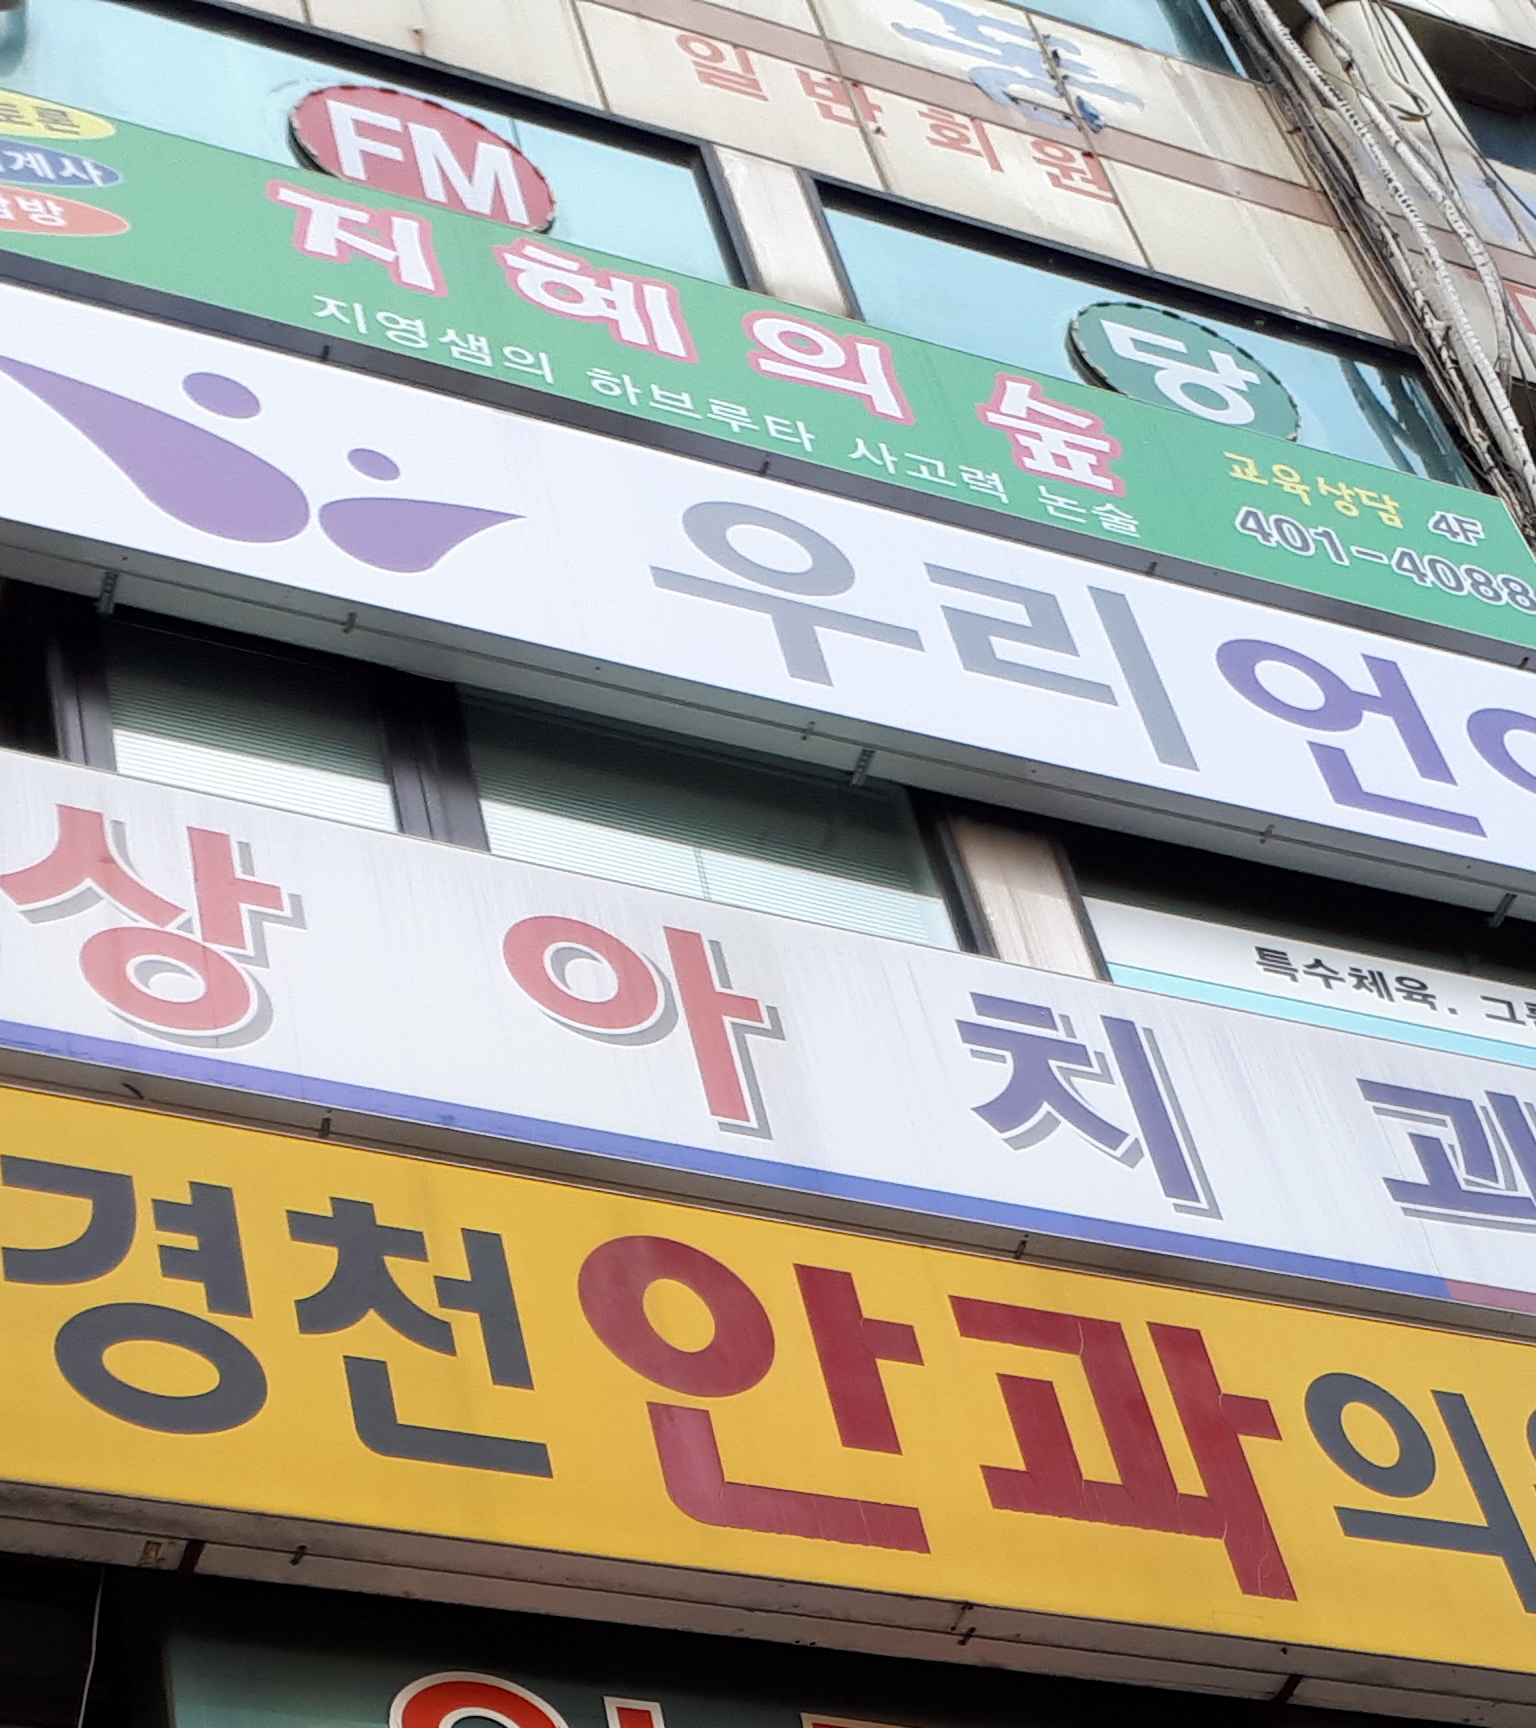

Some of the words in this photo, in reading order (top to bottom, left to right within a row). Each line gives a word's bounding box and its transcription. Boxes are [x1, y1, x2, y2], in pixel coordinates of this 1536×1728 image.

[327, 99, 530, 226] FM
[313, 294, 555, 385] 지영샘의
[586, 366, 816, 456] 하브루타
[850, 435, 1007, 505] 사고력
[1036, 484, 1142, 538] 논술
[1098, 317, 1262, 427] 당
[1222, 450, 1404, 532] 교육상담
[1428, 508, 1486, 547] 4F
